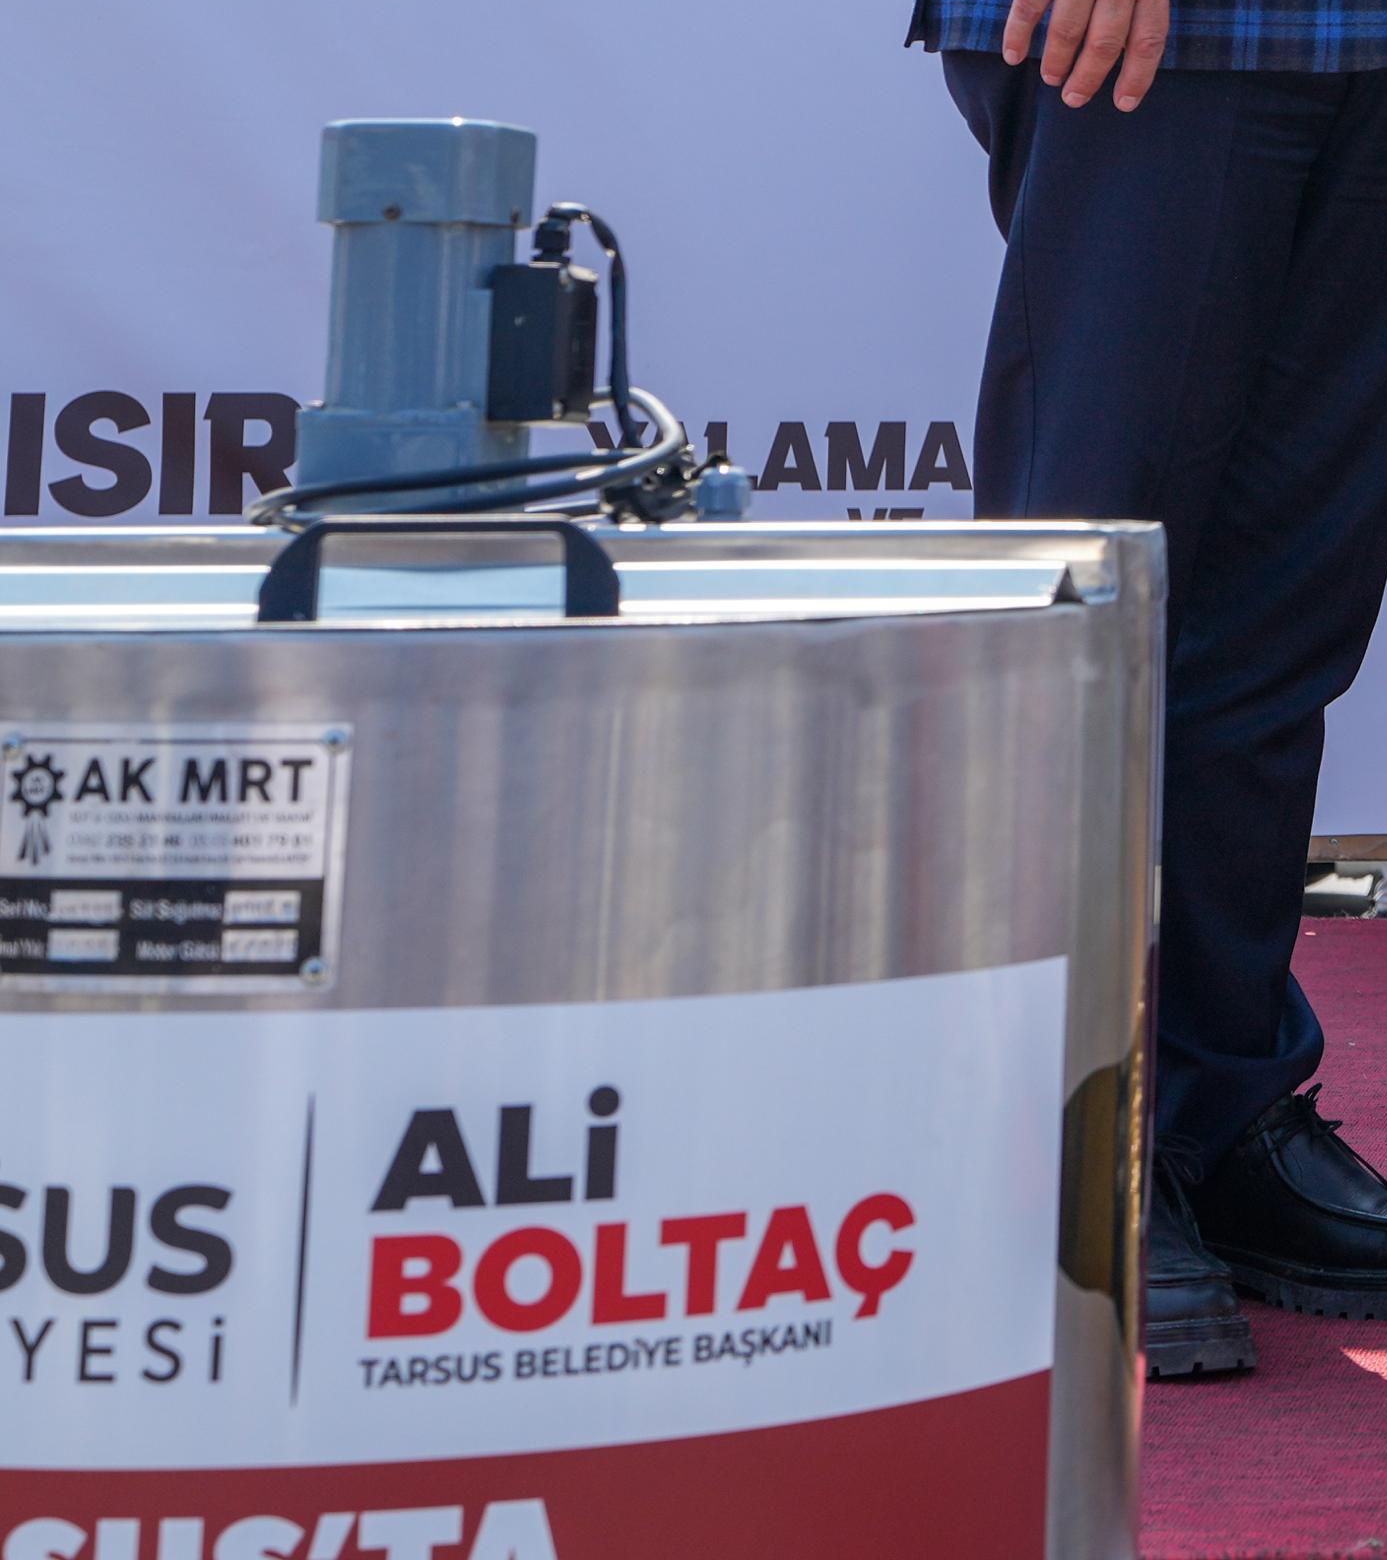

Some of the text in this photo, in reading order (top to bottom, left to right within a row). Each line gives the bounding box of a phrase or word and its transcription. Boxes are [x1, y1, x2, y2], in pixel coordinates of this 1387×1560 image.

[75, 756, 314, 803] AK MRT
[366, 1192, 918, 1340] BOLTAÇ
[359, 1351, 502, 1390] TARSUS
[692, 1319, 834, 1367] BAŞKANI
